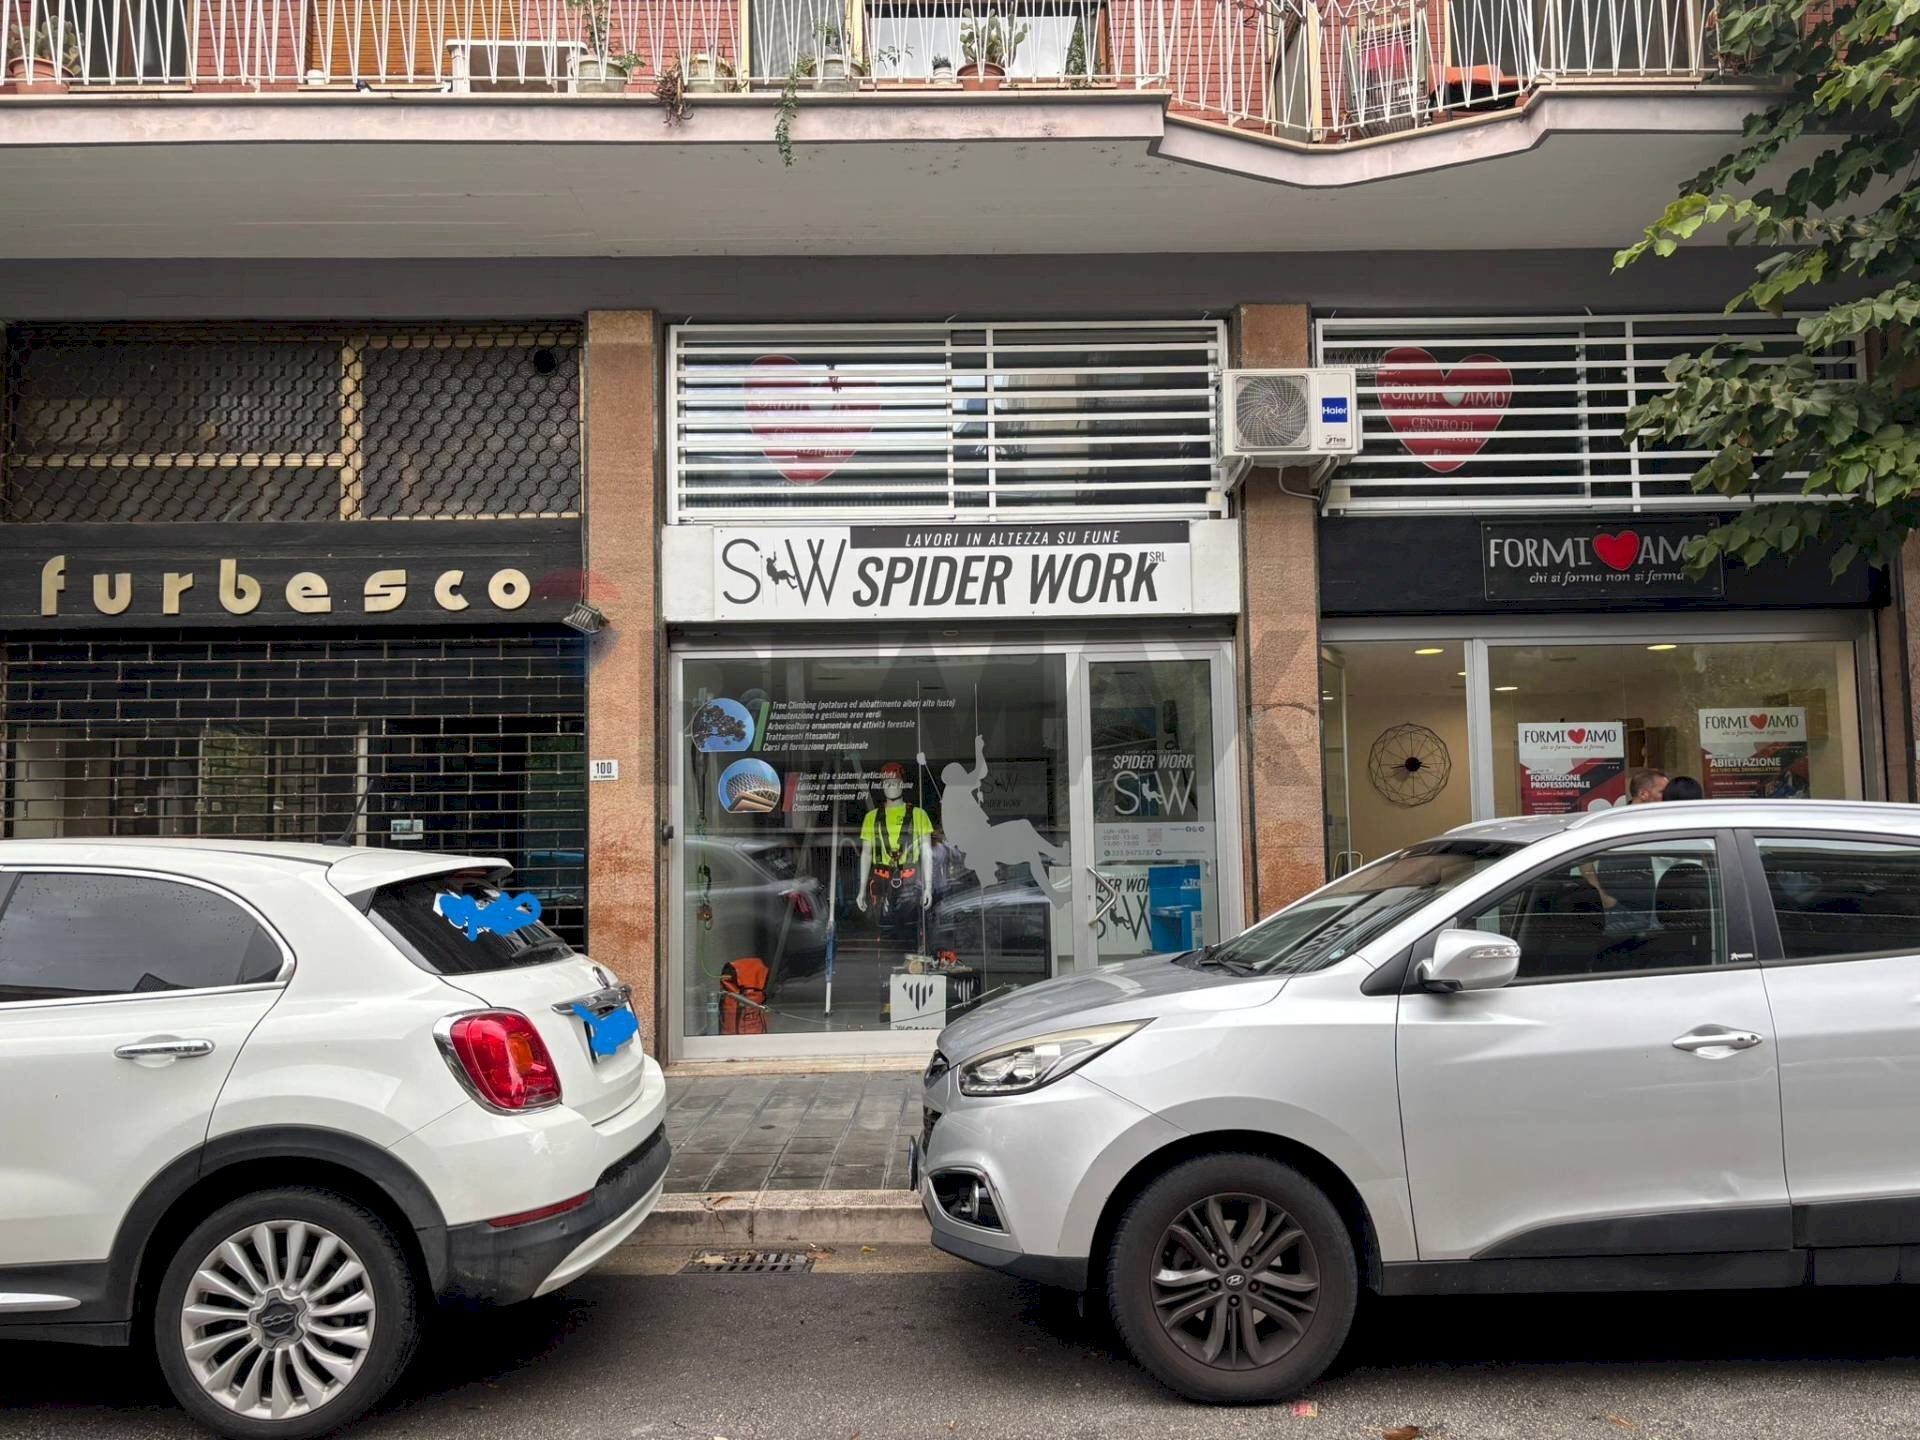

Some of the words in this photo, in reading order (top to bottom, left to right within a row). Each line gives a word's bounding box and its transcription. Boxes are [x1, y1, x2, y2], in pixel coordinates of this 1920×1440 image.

[1322, 406, 1347, 415] Haier
[1411, 417, 1459, 431] CENTRO
[905, 533, 959, 547] LAVORI
[966, 532, 982, 546] IN
[988, 531, 1049, 546] ALTEZZA
[1057, 531, 1077, 544] SU
[1083, 530, 1121, 544] FUNE
[1149, 551, 1167, 563] SRL
[1489, 537, 1593, 568] FORMI
[1638, 534, 1707, 567] AM
[852, 554, 1013, 607] SPIDER
[1029, 551, 1159, 605] WORK
[1529, 571, 1548, 584] chi
[1551, 571, 1561, 583] si
[1562, 571, 1602, 586] forma
[1606, 573, 1630, 582] non
[1634, 570, 1645, 582] si
[1646, 569, 1685, 585] ferma
[41, 555, 531, 616] furbesco
[773, 701, 787, 709] Tree
[788, 701, 817, 710] Climbing
[849, 700, 858, 709] ed
[859, 700, 901, 708] abbattimento
[922, 699, 935, 707] alto
[770, 711, 814, 720] Manutenzione
[820, 711, 848, 720] gestione
[865, 711, 881, 719] verdi
[1705, 716, 1749, 729] FORMI
[1768, 714, 1799, 728] AMO
[811, 721, 852, 730] ornamentale
[852, 721, 861, 729] ed
[887, 720, 915, 728] forestale
[766, 732, 804, 741] Trattamenti
[1524, 730, 1567, 743] FORMI
[1586, 728, 1617, 743] AMO
[763, 743, 780, 751] Corsi
[781, 742, 788, 751] di
[789, 742, 825, 751] formazione
[825, 741, 869, 751] professionale
[1112, 754, 1155, 769] SPIDER
[1157, 754, 1195, 769] WORK
[1710, 757, 1781, 767] ABILITAZIONE
[596, 762, 612, 774] 100
[838, 771, 861, 780] sistemi
[1530, 781, 1591, 789] PROFESSIONALE
[827, 792, 856, 801] revisione
[856, 791, 870, 801] DPI
[1096, 878, 1122, 893] DER
